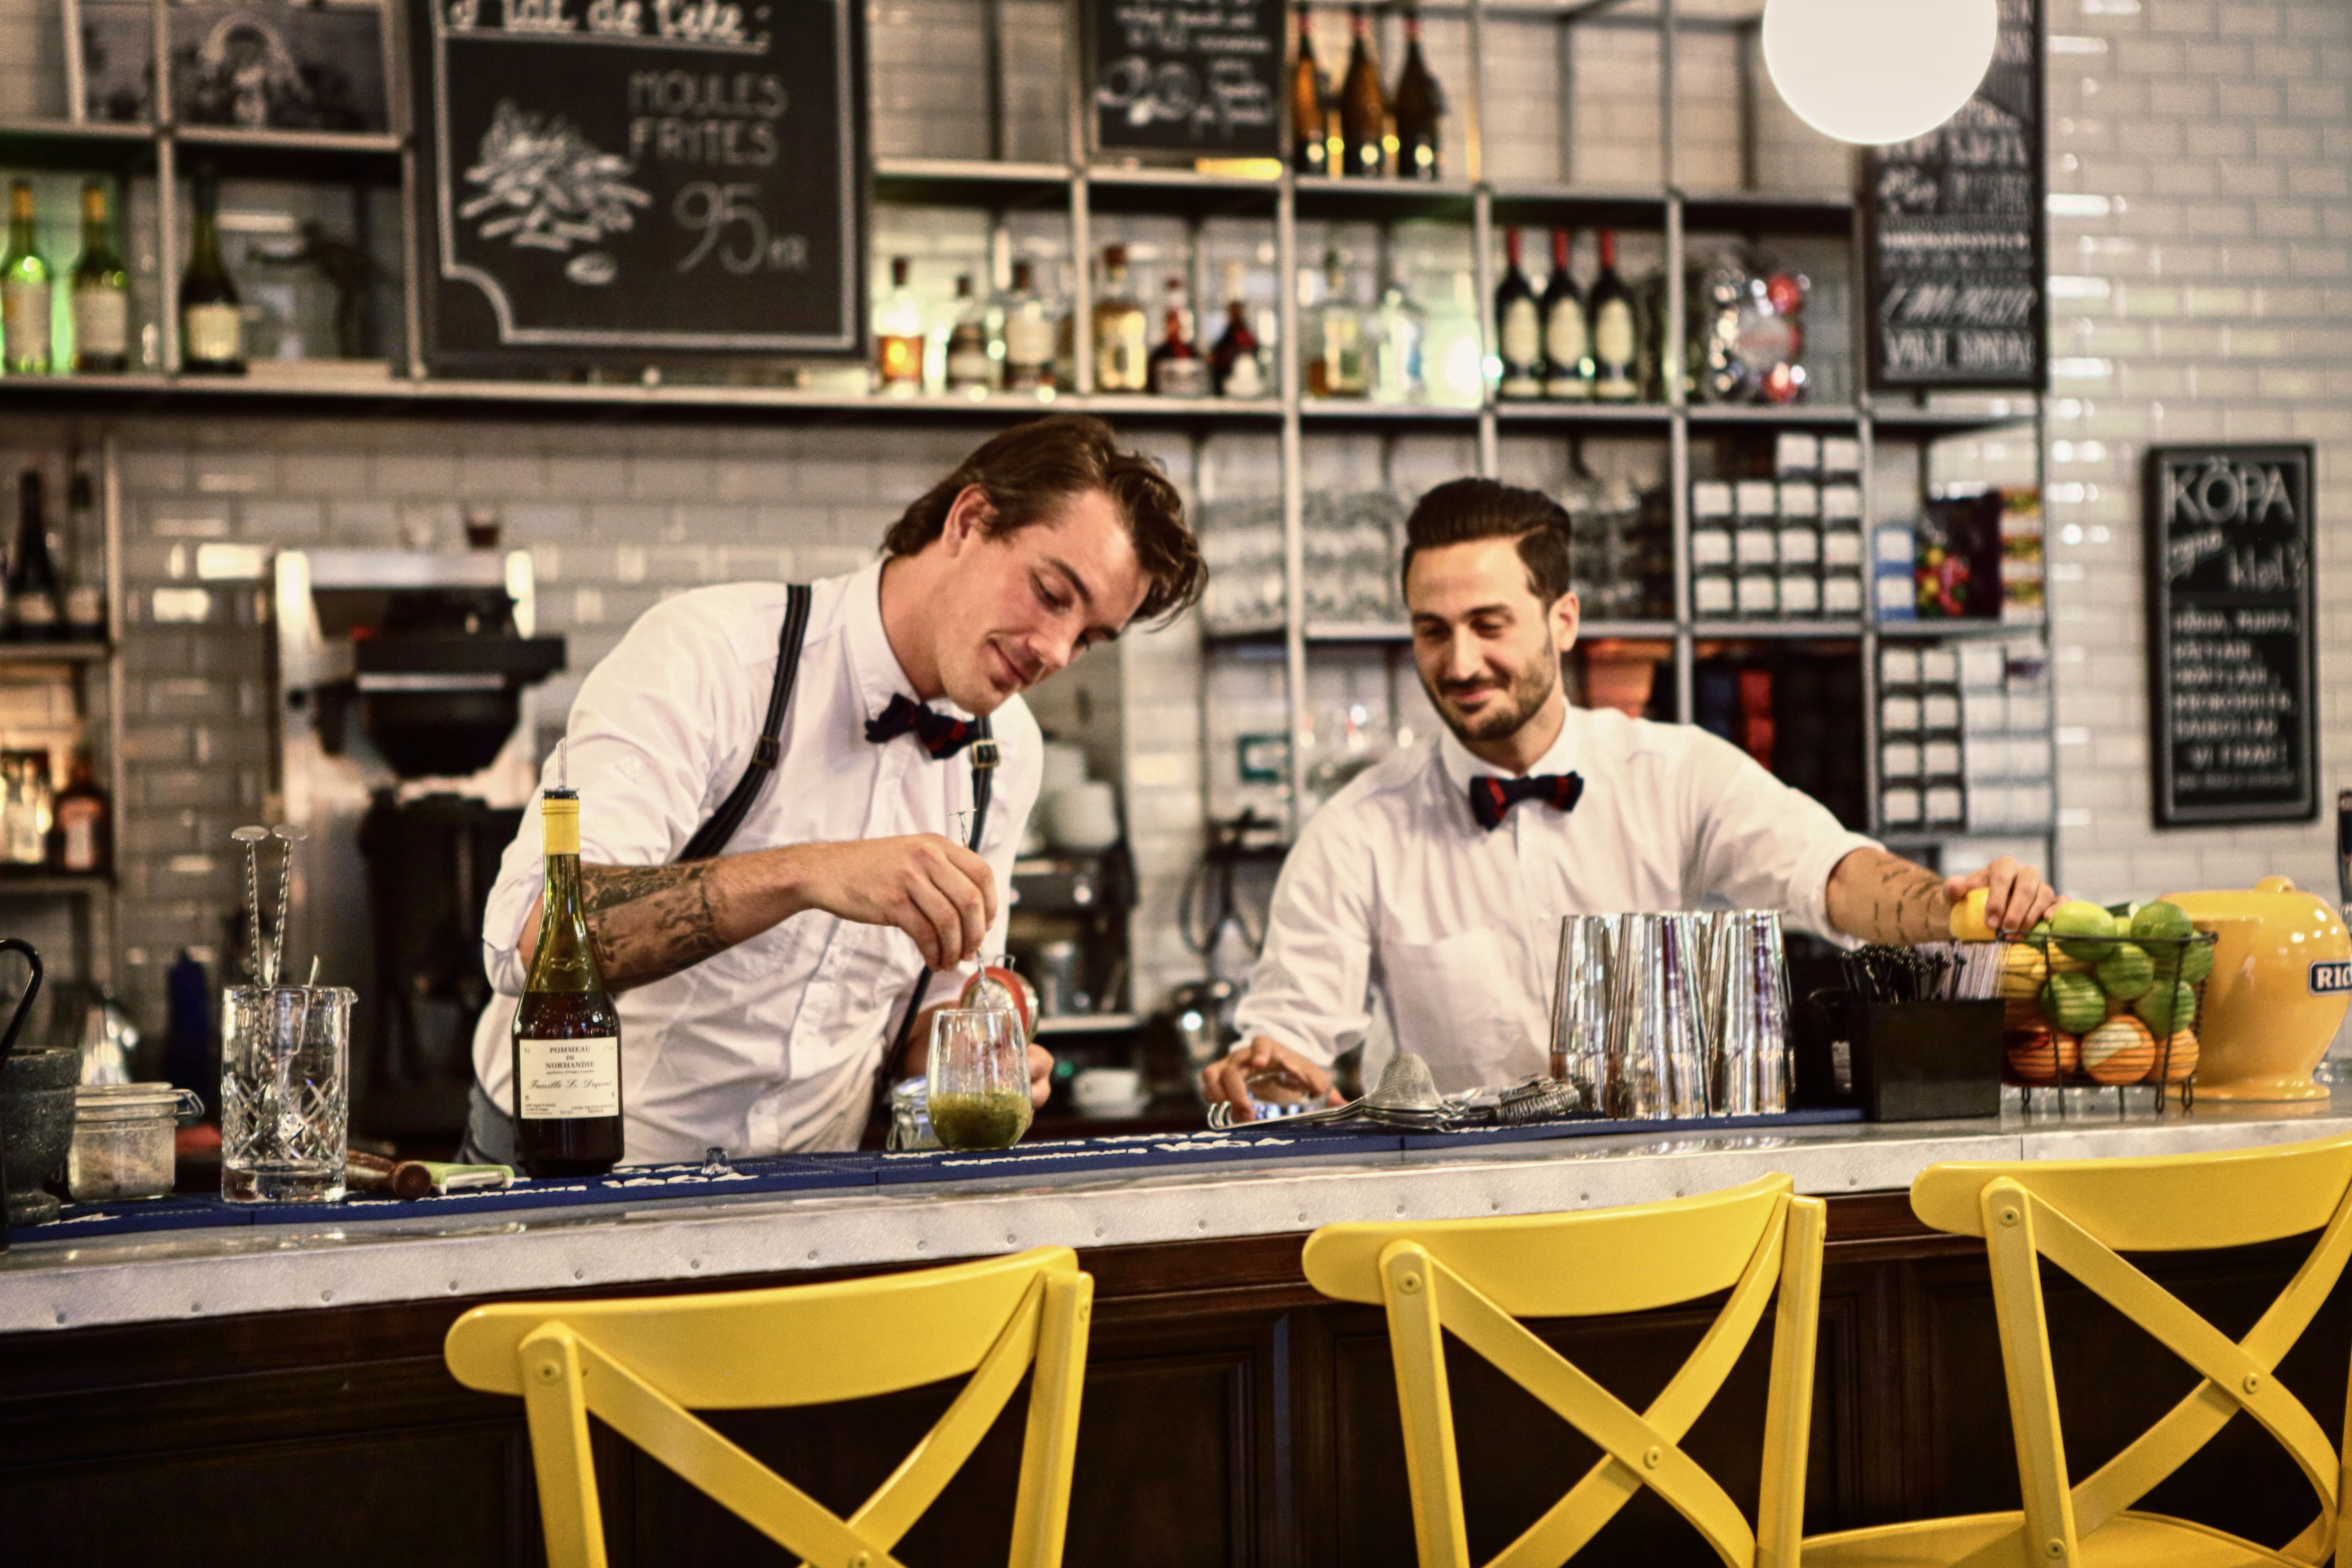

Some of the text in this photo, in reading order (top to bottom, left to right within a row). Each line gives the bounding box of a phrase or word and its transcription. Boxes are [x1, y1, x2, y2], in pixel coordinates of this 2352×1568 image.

[629, 69, 788, 118] MOULES
[629, 117, 778, 166] FRITES
[2164, 455, 2296, 523] KÖPA
[529, 1080, 562, 1089] Famille
[583, 1079, 612, 1089] Dupont
